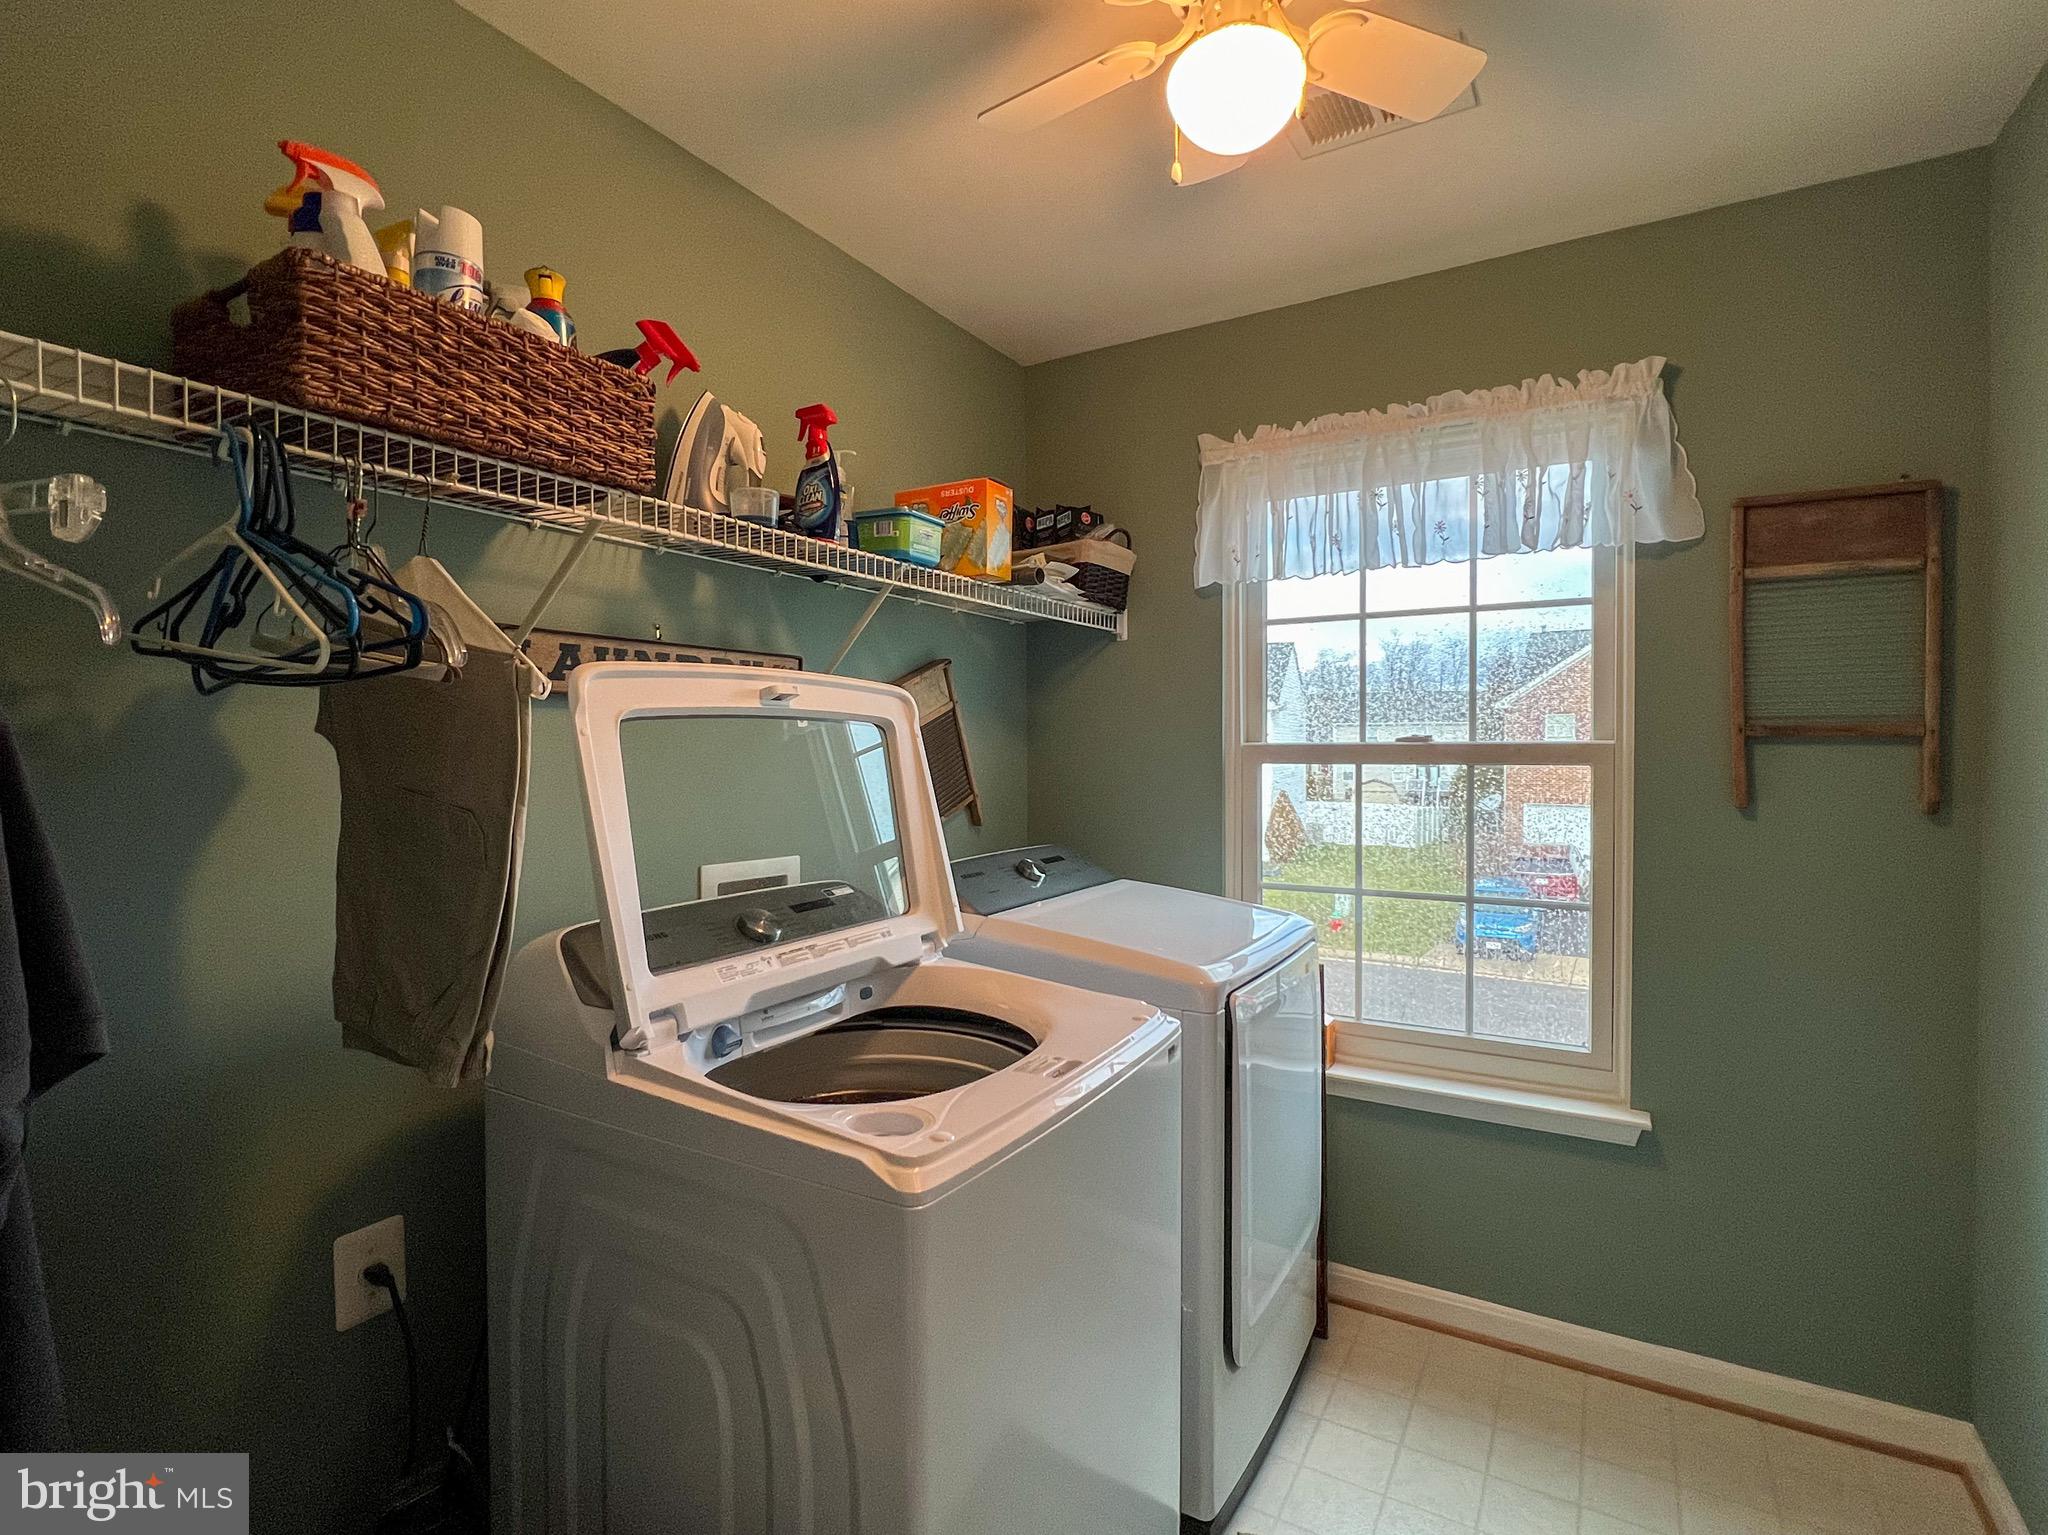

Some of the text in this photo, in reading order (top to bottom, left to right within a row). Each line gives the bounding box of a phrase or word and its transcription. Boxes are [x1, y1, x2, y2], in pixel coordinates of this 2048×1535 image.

[803, 484, 819, 496] OXI
[940, 486, 975, 498] DUSTERS
[940, 503, 980, 521] Swiffe
